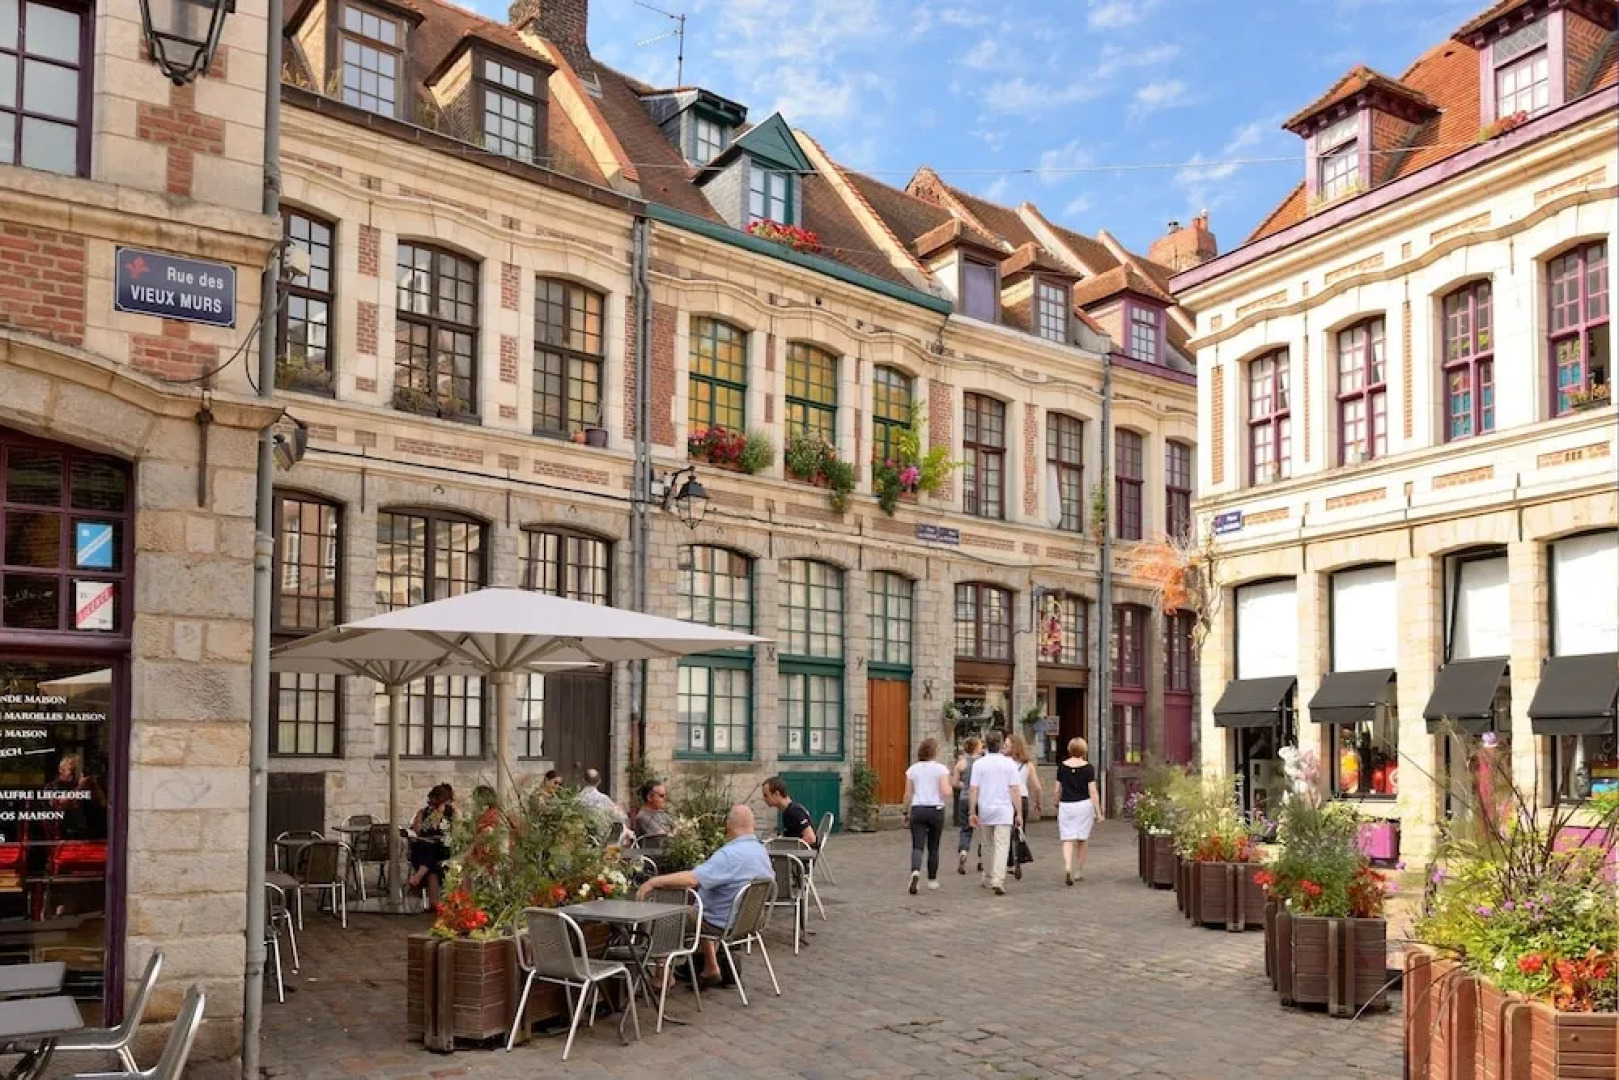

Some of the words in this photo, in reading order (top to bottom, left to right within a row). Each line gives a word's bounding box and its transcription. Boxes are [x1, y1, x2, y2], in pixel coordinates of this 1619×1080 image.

[167, 266, 194, 284] Rue
[198, 272, 224, 289] des
[130, 284, 175, 306] VIEUX
[180, 292, 222, 313] MURS
[24, 695, 67, 704] MAISON
[4, 712, 63, 720] MAROILLES
[65, 713, 106, 721] MAISON
[4, 729, 48, 738] MAISON
[18, 811, 65, 821] MAISON
